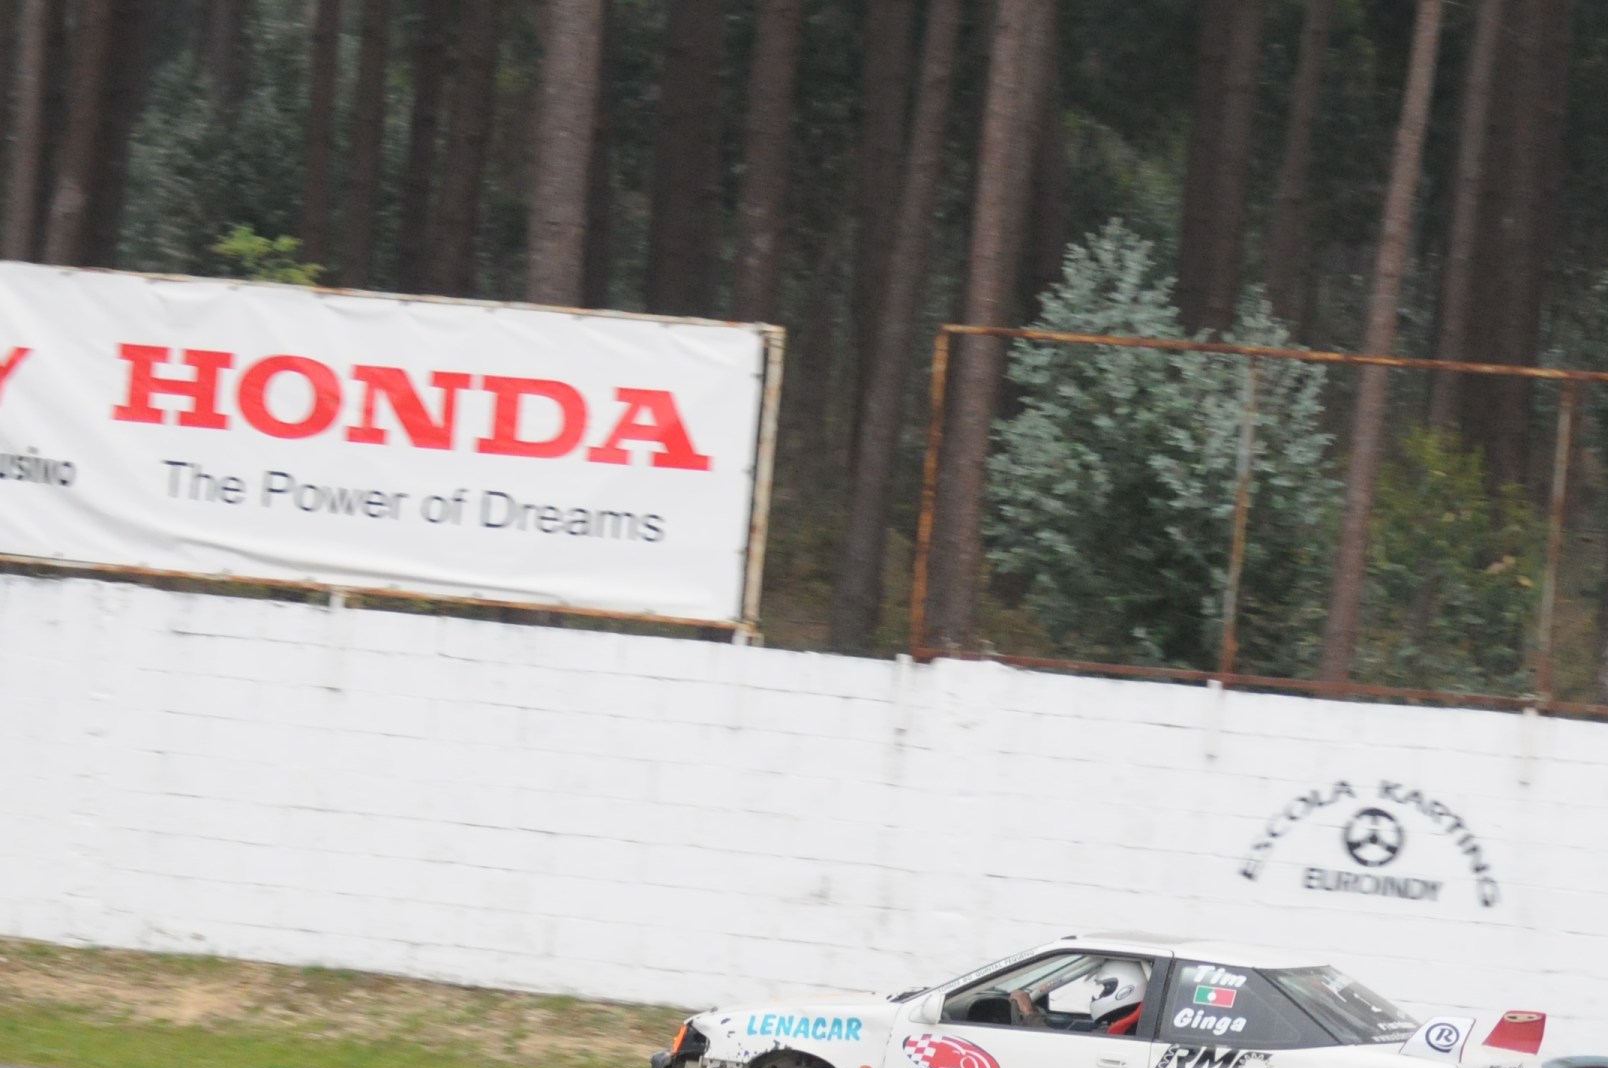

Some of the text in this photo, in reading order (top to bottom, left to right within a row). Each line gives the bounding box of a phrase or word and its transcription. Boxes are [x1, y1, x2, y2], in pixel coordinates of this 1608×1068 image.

[112, 343, 712, 471] HONDA
[162, 460, 665, 543] The Power of Dreams
[1378, 780, 1501, 907] KARTING
[1303, 867, 1443, 901] EUROINDY
[1193, 965, 1247, 987] Tim
[747, 1014, 862, 1041] LENACAR
[1173, 1007, 1247, 1036] Ginga
